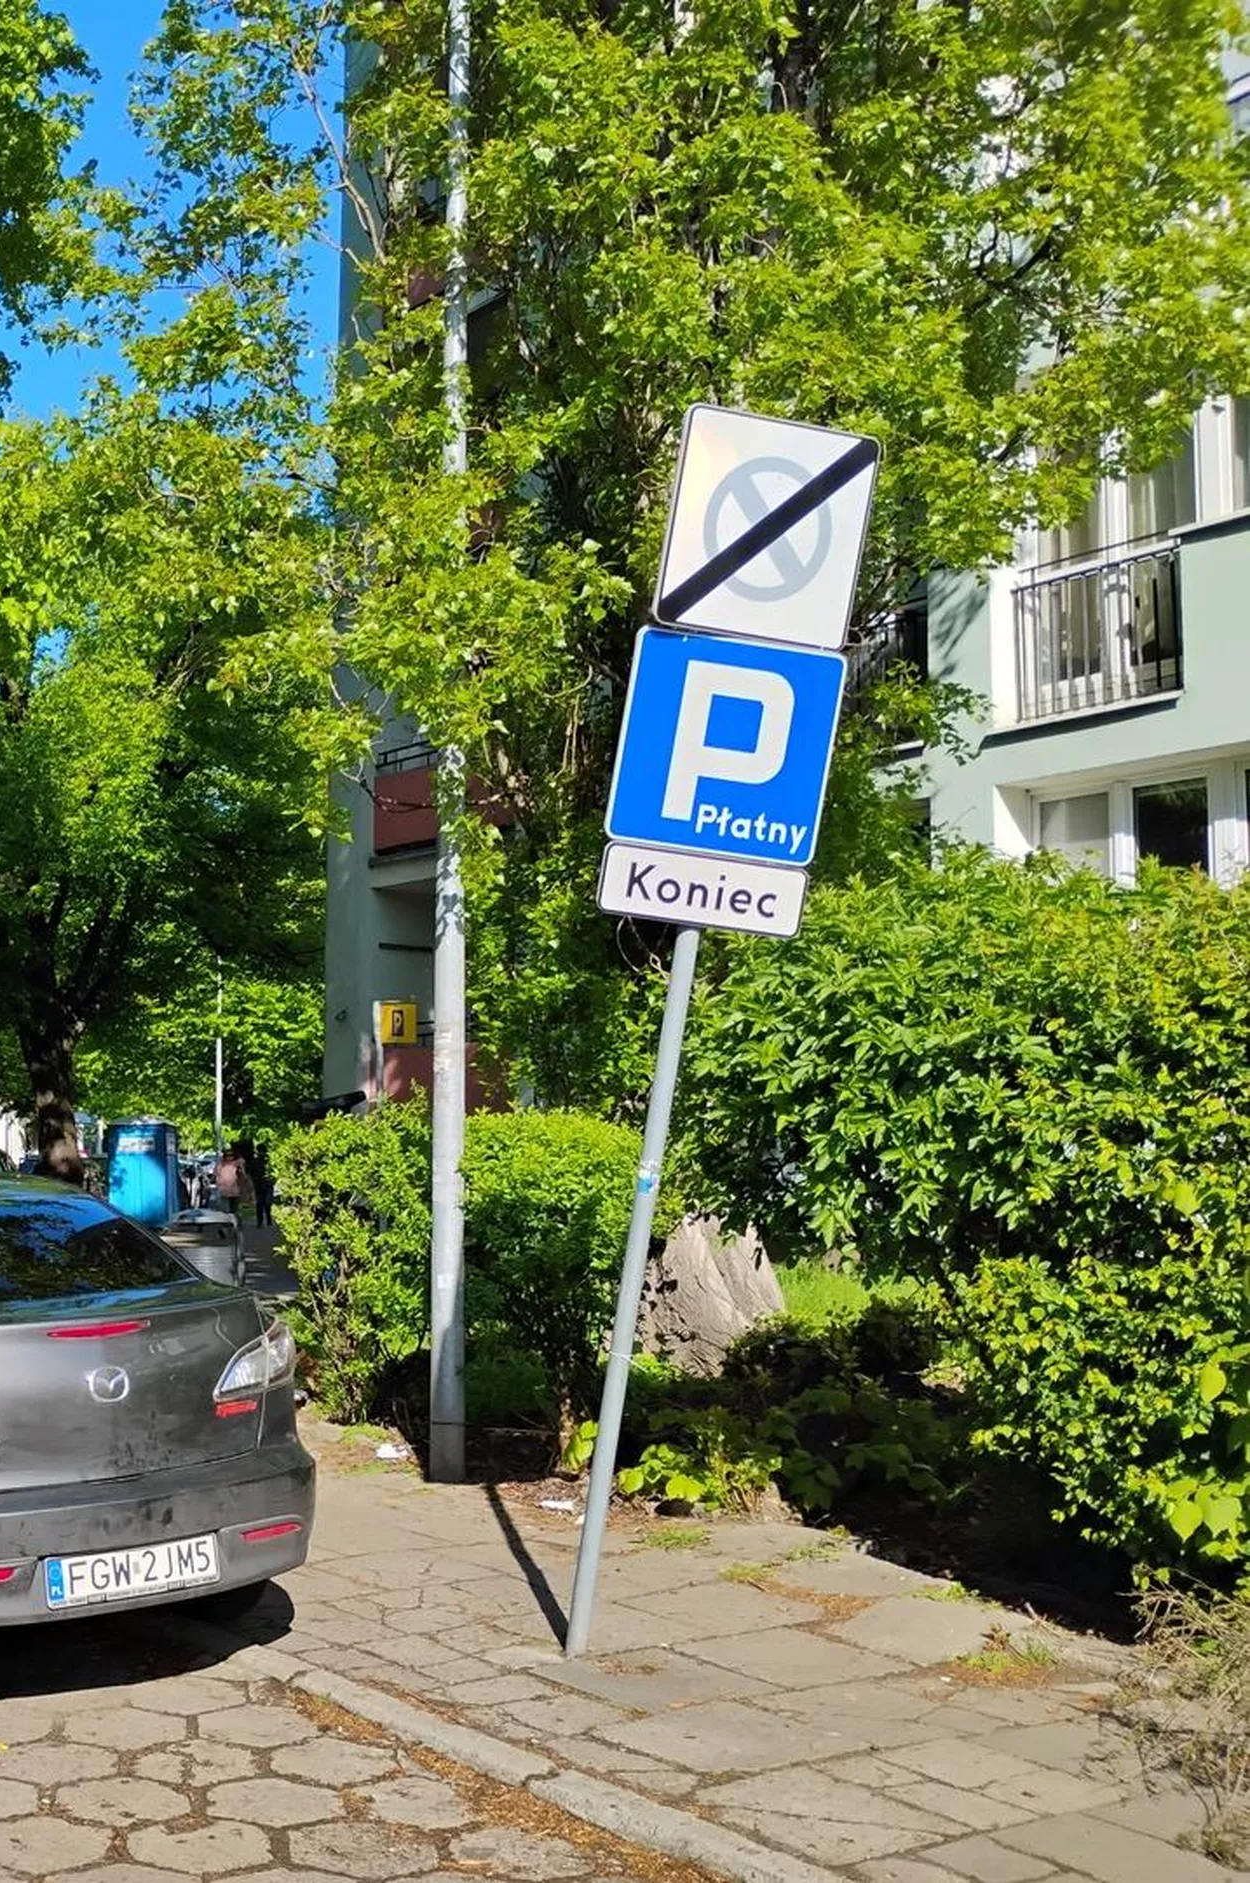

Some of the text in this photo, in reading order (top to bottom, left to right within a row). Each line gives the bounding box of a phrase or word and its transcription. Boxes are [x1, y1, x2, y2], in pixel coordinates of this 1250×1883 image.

[661, 659, 795, 821] P
[695, 803, 807, 855] Płatny
[625, 861, 777, 918] Koniec
[393, 1012, 402, 1034] P
[68, 1541, 210, 1595] FGW 2JM5
